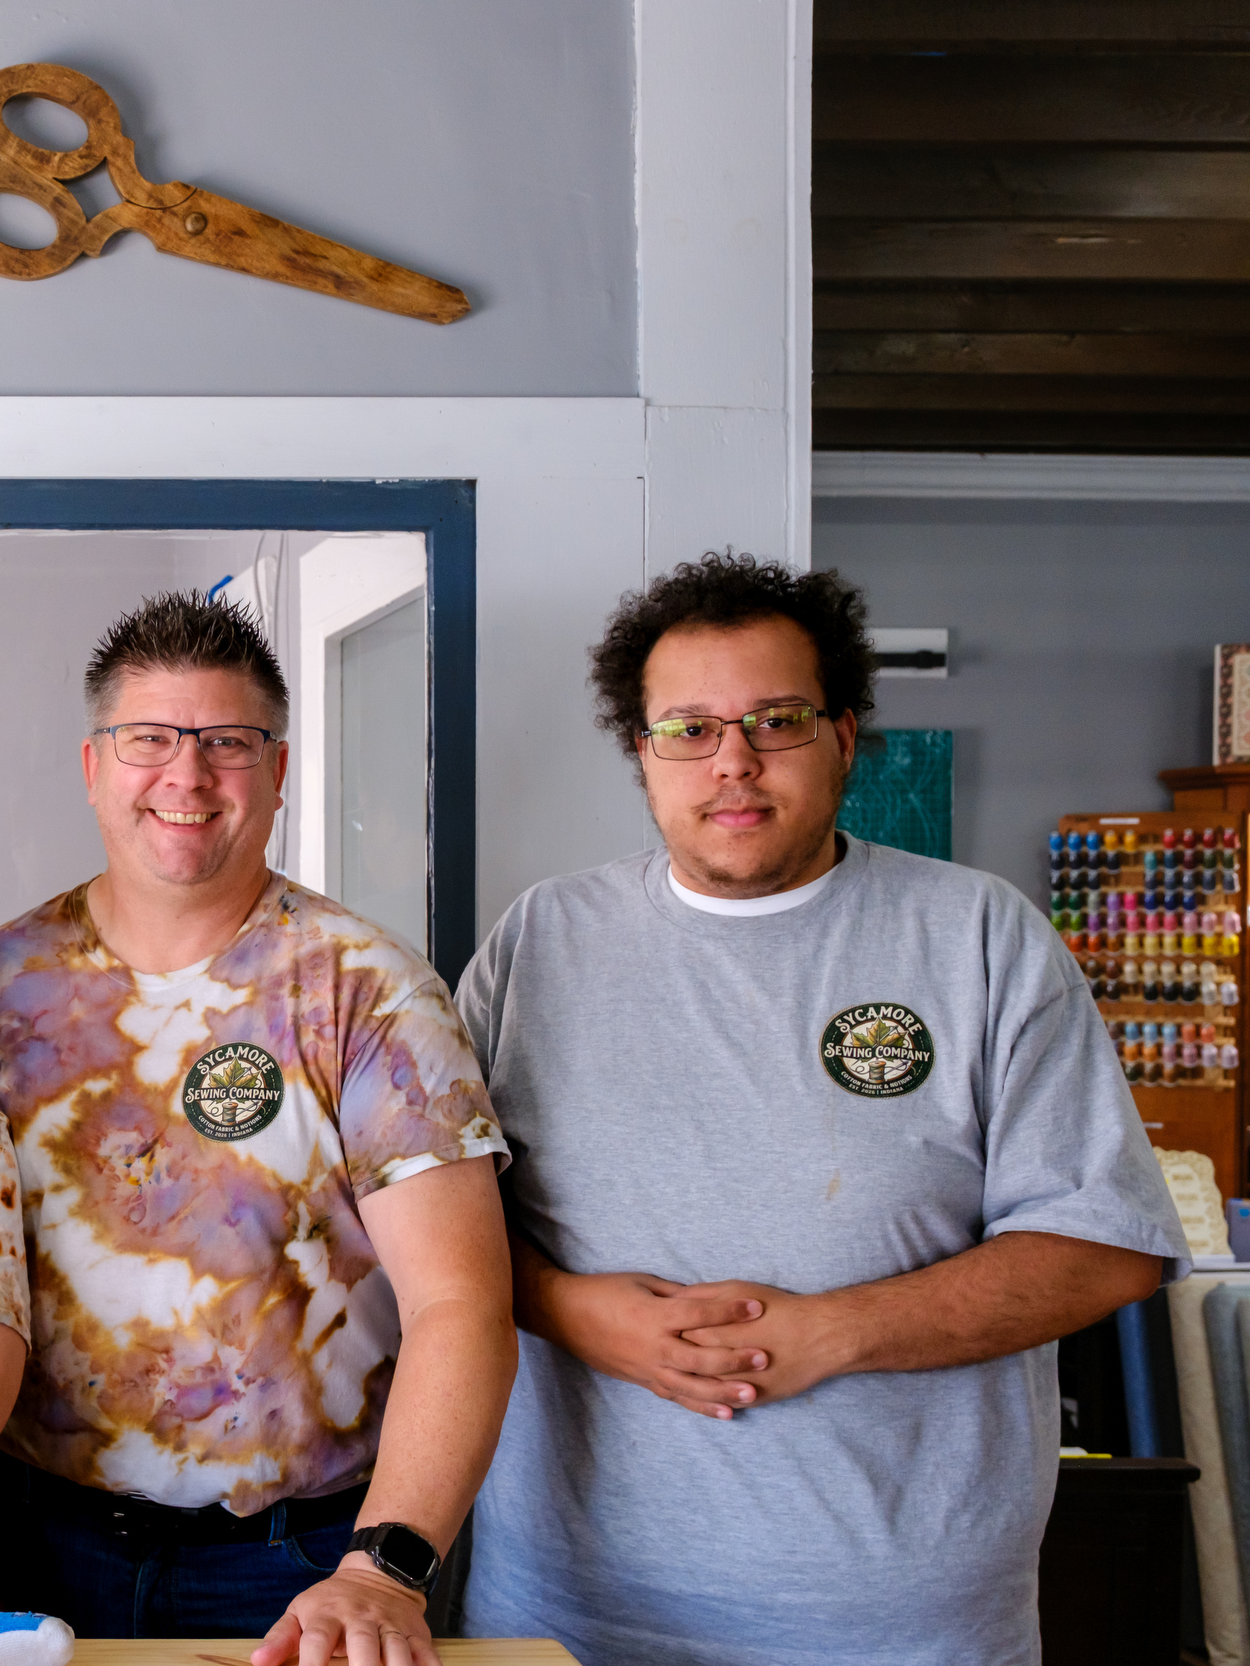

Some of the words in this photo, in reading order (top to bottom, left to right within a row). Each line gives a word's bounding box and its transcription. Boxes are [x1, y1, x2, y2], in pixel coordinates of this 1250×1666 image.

[835, 1006, 922, 1035] SYCAMORE
[197, 1046, 274, 1074] SYCAMORE
[841, 1071, 861, 1085] COTTON
[890, 1075, 912, 1088] NOTIONS
[199, 1115, 215, 1129] COTTON
[240, 1115, 262, 1129] NOTIONS
[232, 1128, 253, 1137] INDIANA
